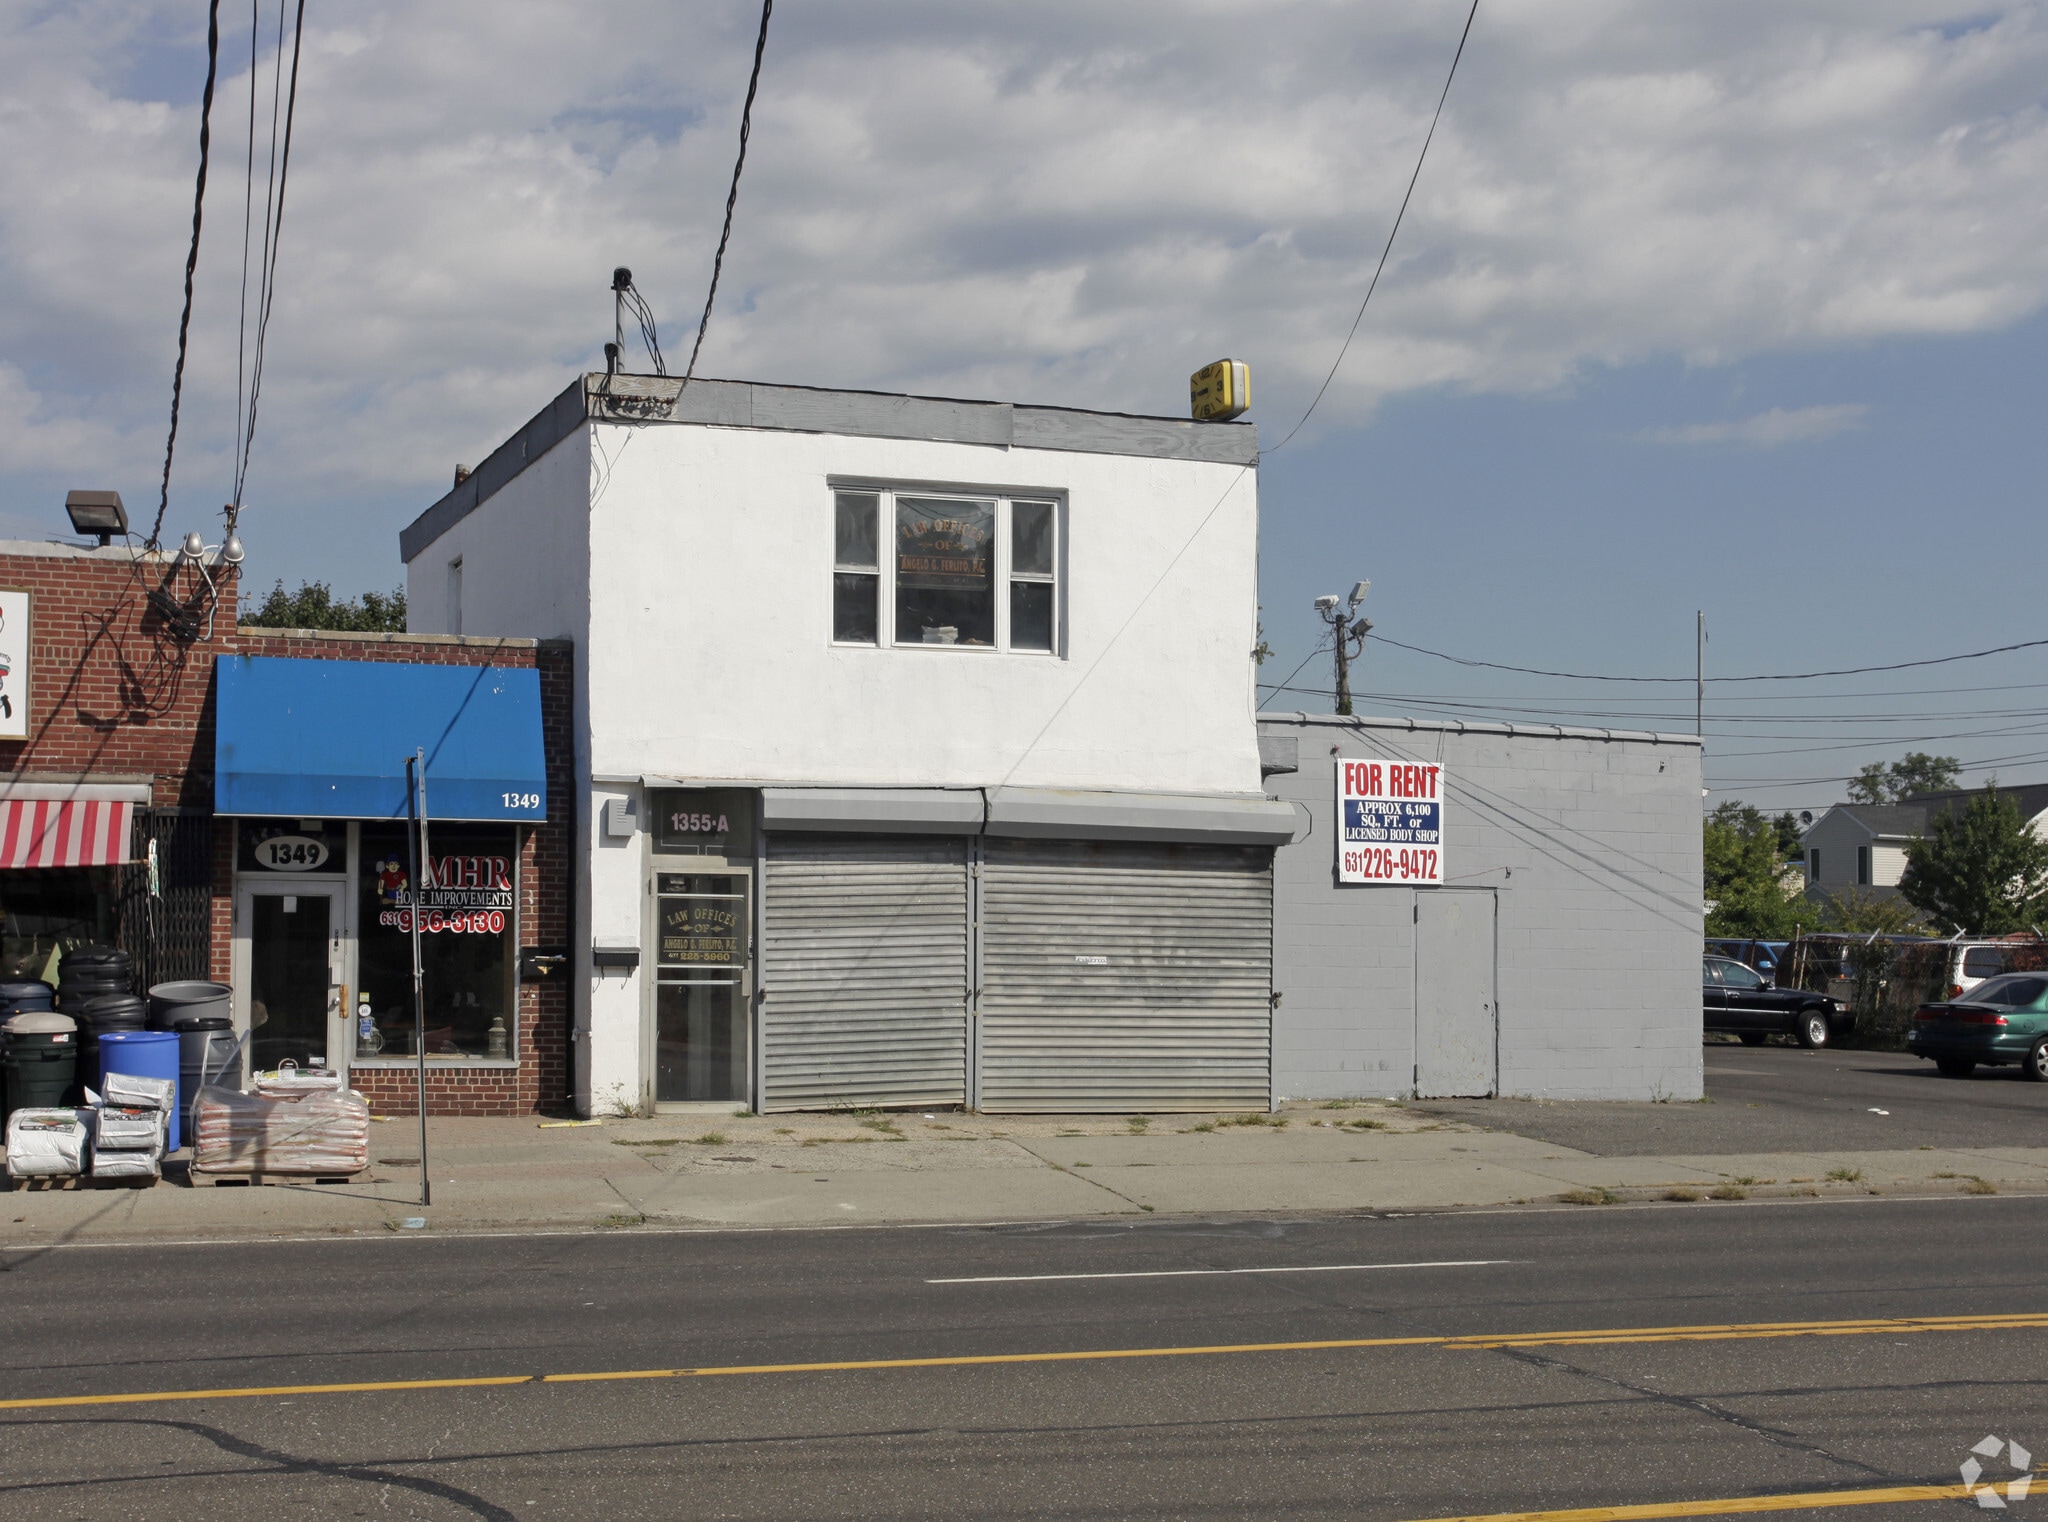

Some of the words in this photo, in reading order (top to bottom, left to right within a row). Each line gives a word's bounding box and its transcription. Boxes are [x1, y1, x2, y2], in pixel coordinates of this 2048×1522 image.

[1217, 380, 1222, 391] 3
[1204, 404, 1209, 415] 6
[934, 540, 953, 551] OF
[1345, 763, 1382, 796] FOR
[1390, 764, 1439, 798] RENT
[501, 792, 540, 809] 1349
[1356, 801, 1403, 815] APPROX
[1405, 803, 1431, 817] 6,100
[1383, 815, 1402, 828] FT.
[1409, 819, 1423, 828] or
[1346, 827, 1388, 841] LICENSED
[1390, 829, 1413, 841] BODY
[1415, 830, 1438, 842] SHOP
[269, 842, 320, 866] 1349
[1345, 851, 1363, 872] 631
[1363, 847, 1437, 879] 226-9472
[420, 855, 512, 891] MHR
[430, 891, 513, 906] IMPROVEMENTS
[379, 910, 400, 926] 631
[398, 909, 505, 934] 956-3130
[666, 909, 689, 926] LAW
[693, 907, 738, 927] OFFICES
[693, 923, 711, 933] OF
[664, 938, 689, 950] ANGELO
